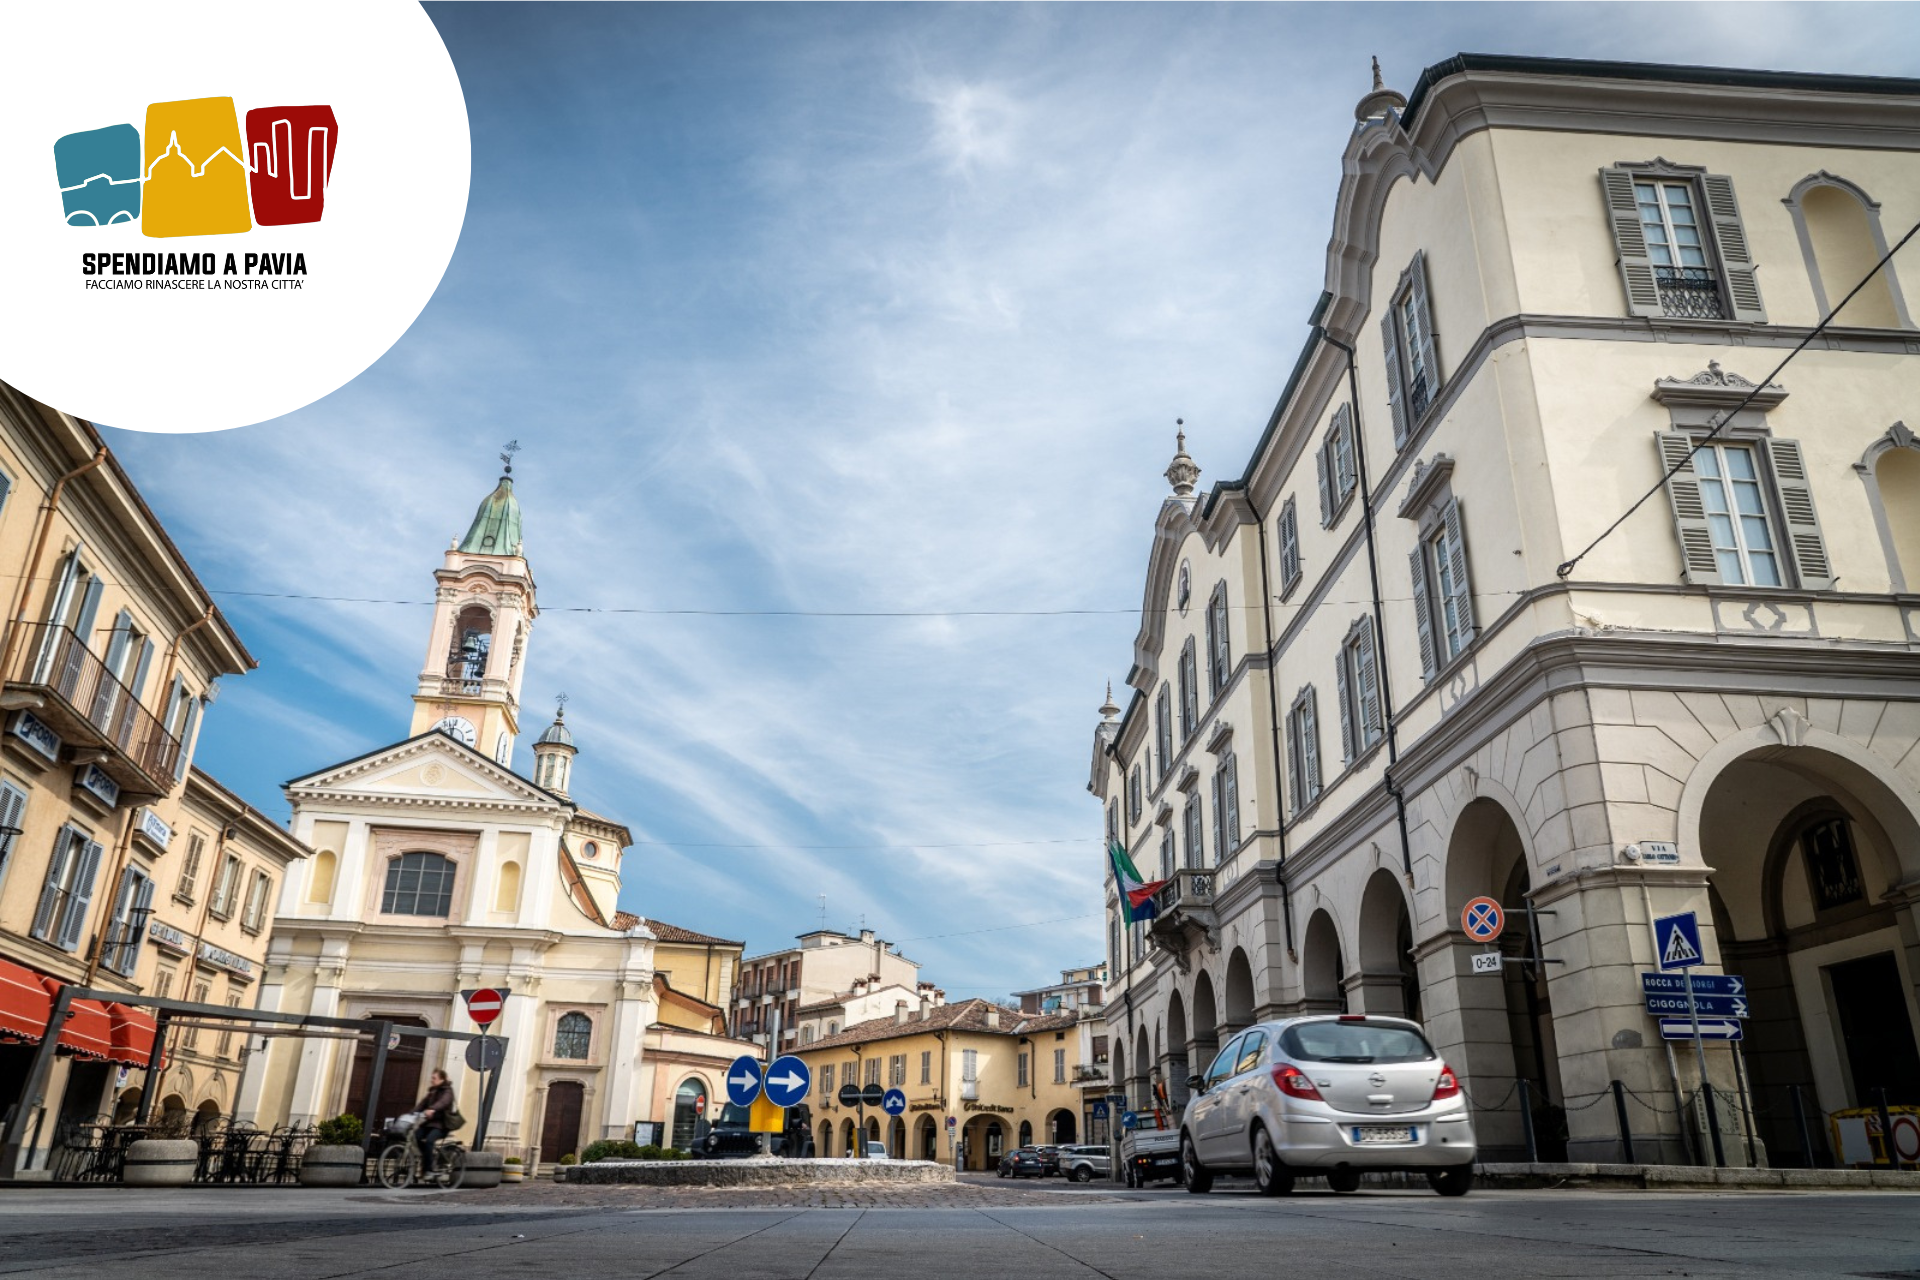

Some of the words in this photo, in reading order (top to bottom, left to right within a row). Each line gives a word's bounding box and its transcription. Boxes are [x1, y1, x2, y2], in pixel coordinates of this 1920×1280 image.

[31, 721, 58, 752] FORNI
[95, 772, 118, 798] FORNI
[1476, 956, 1497, 969] 0-24
[1645, 978, 1672, 988] ROCCA
[1691, 980, 1715, 989] IORGI
[1649, 999, 1714, 1011] CIGOGNOLA
